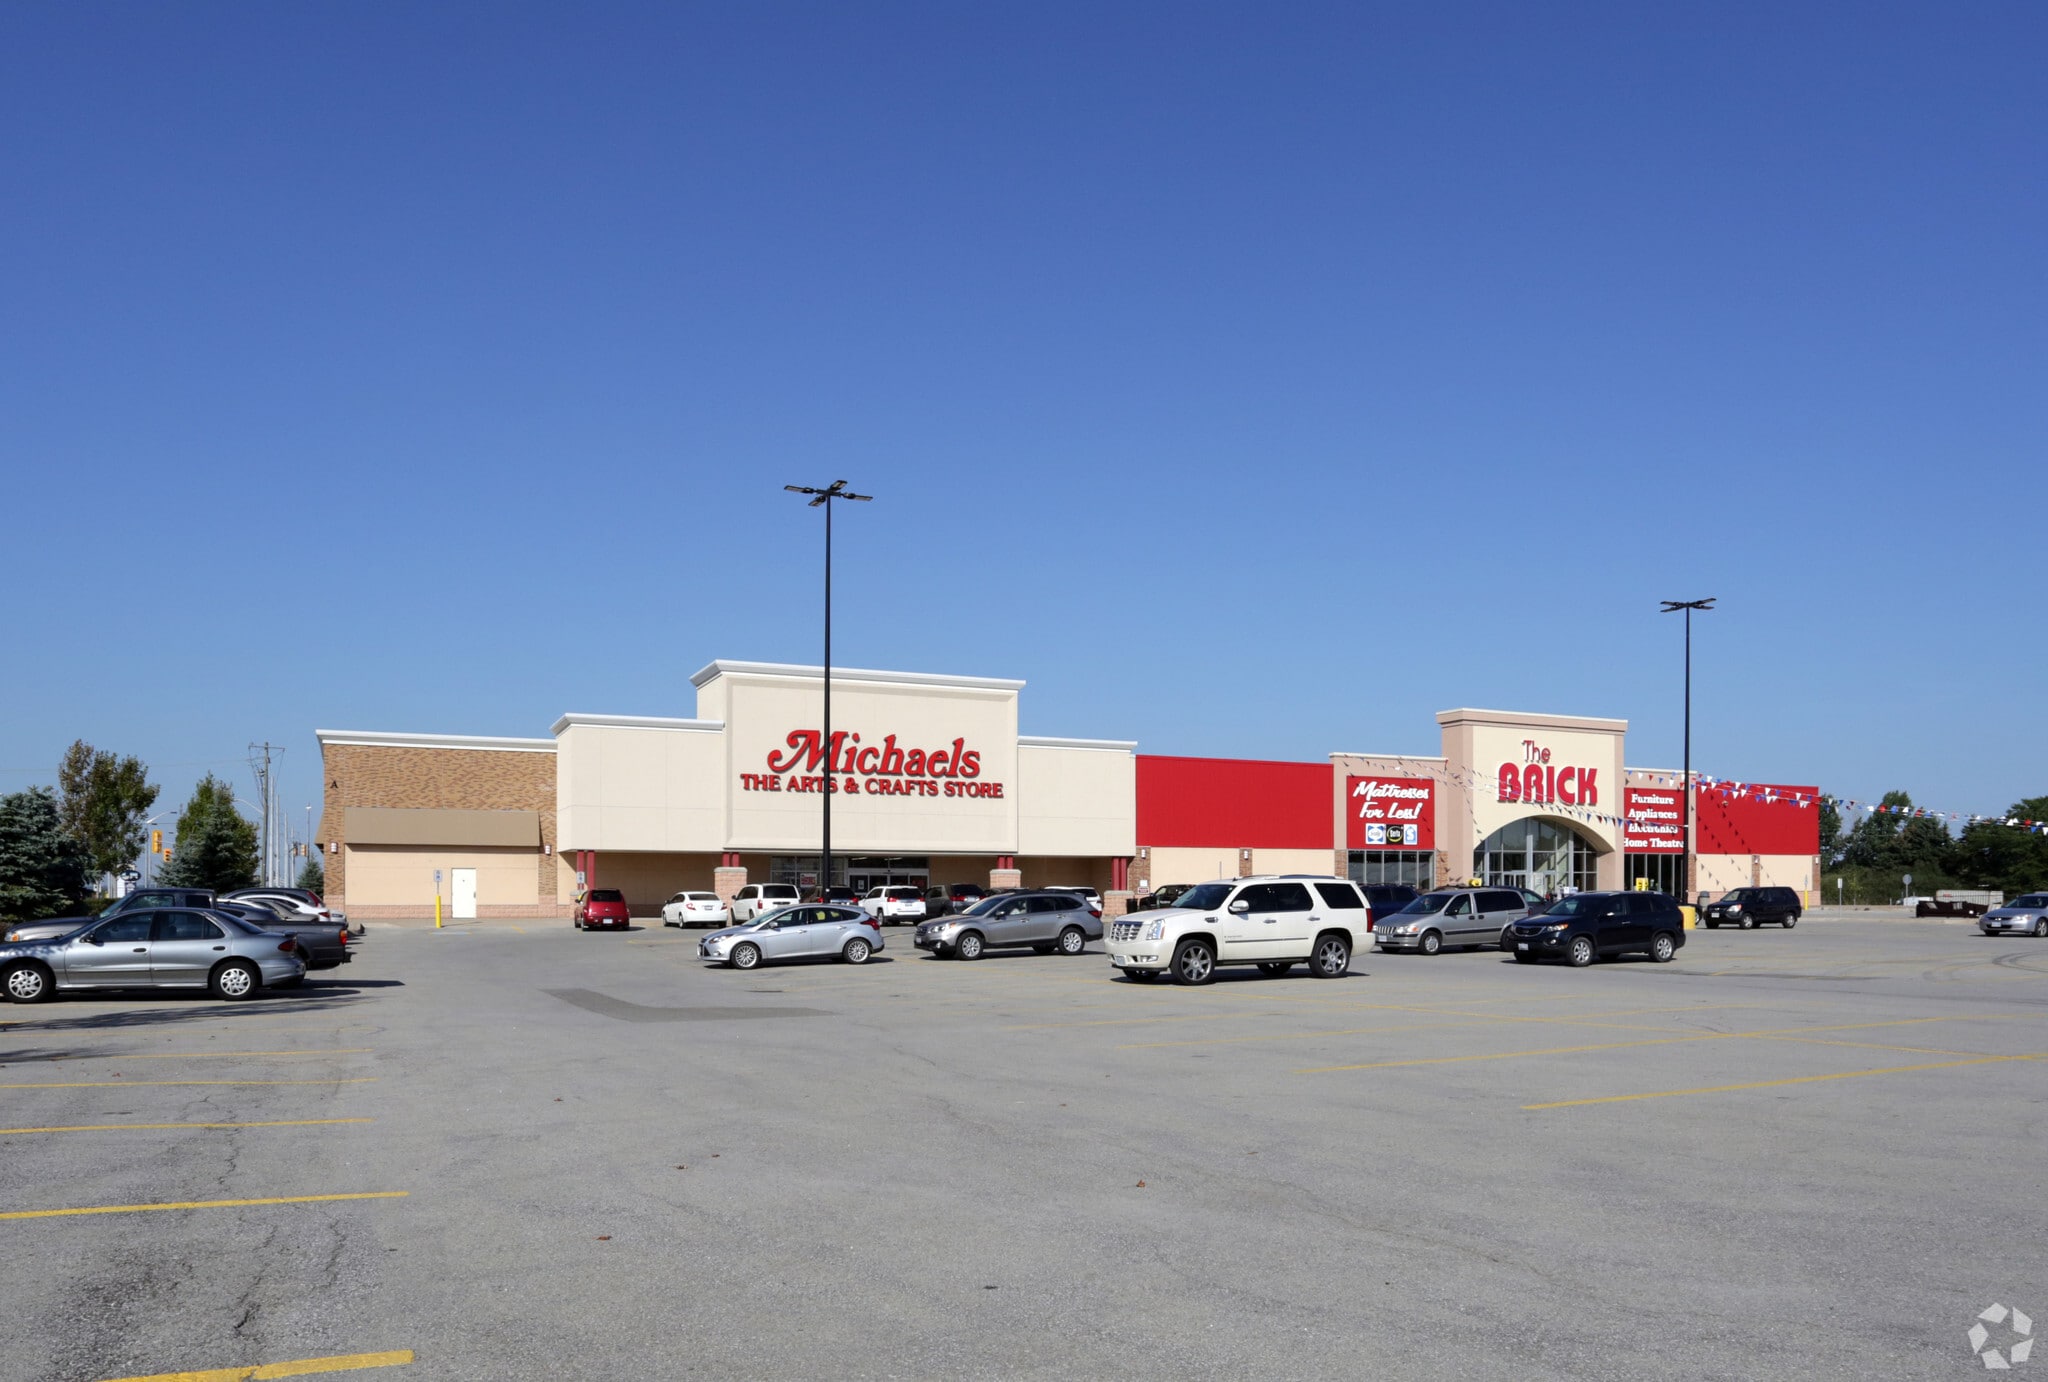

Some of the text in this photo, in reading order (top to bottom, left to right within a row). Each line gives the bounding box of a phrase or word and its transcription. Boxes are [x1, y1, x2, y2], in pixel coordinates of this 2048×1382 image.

[767, 730, 981, 778] Michaels
[1521, 740, 1551, 763] The
[330, 780, 339, 789] A
[740, 773, 1004, 798] THE ARTS & CRAFTS STORE
[1352, 781, 1430, 801] Mattresses
[1498, 762, 1598, 805] BRICK
[1631, 793, 1675, 805] Furniture
[1359, 801, 1385, 818] For
[1627, 808, 1678, 820] Appliances
